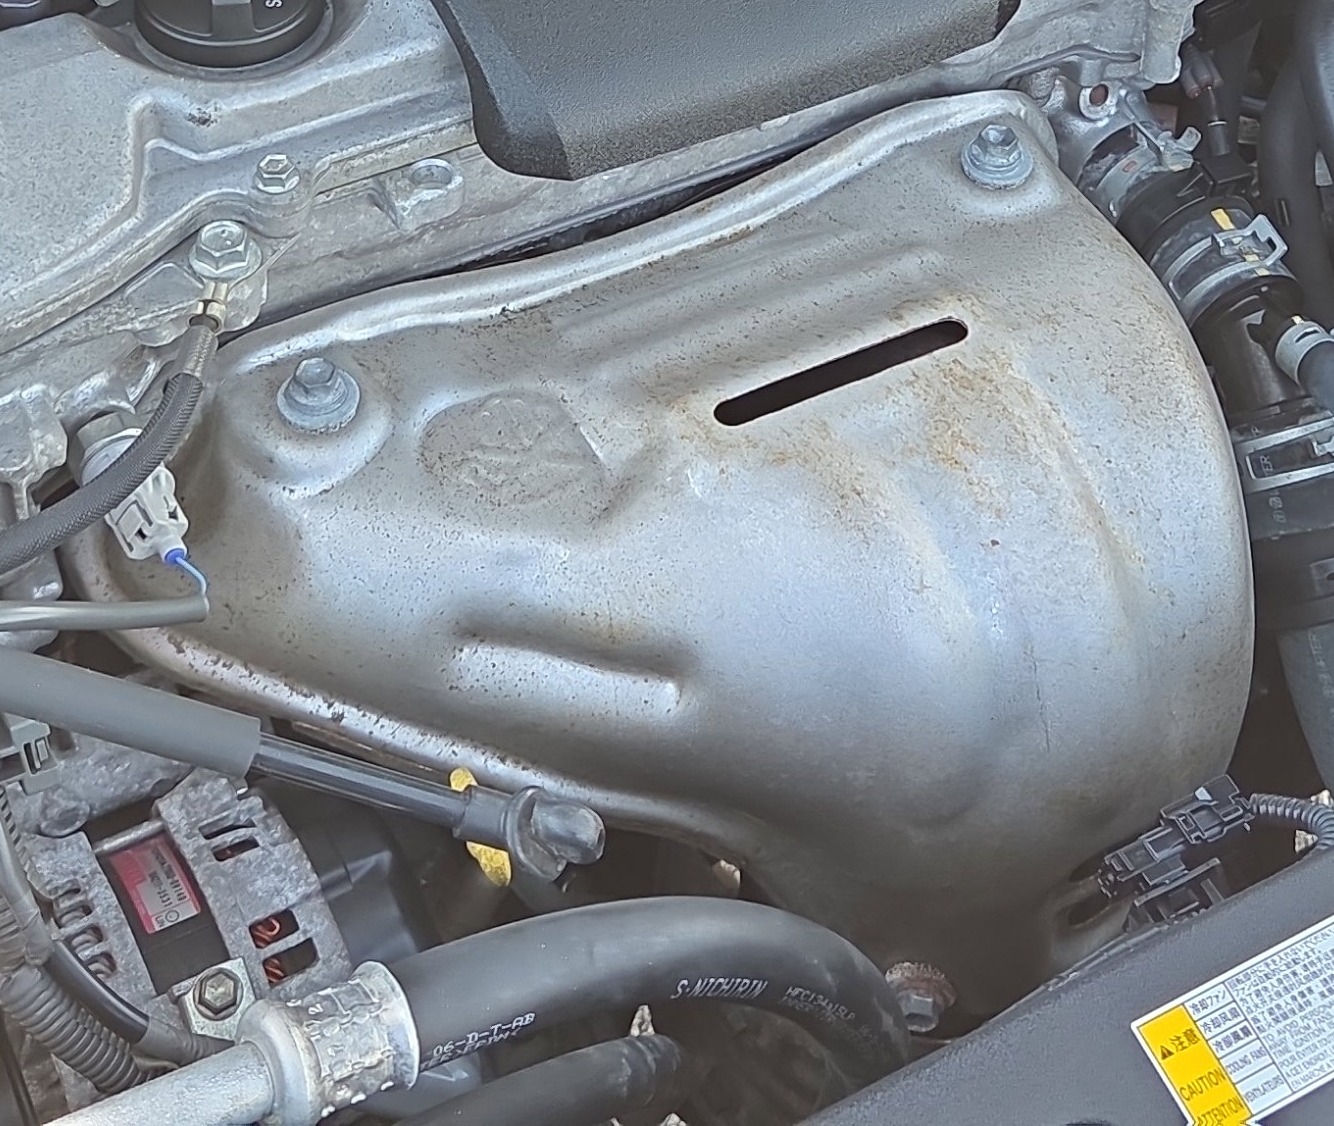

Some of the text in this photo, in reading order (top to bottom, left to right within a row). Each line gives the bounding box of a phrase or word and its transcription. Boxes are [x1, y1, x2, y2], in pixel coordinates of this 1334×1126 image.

[1189, 990, 1226, 1015] 冷却ファン
[1200, 1006, 1241, 1033] 冷却风扇
[1261, 1032, 1275, 1044] TO
[1276, 1019, 1299, 1036] AVOID
[1288, 1022, 1312, 1039] FROM
[1169, 1027, 1200, 1052] 注意
[1272, 1044, 1292, 1059] TIME
[1292, 1026, 1326, 1048] IGNITION
[1225, 1046, 1267, 1075] COOLING FANS
[1278, 1054, 1298, 1068] POUR
[1179, 1067, 1226, 1101] CAUTION
[1243, 1074, 1284, 1102] VENTILATEURS
[1197, 1096, 1244, 1126] ATTENTION
